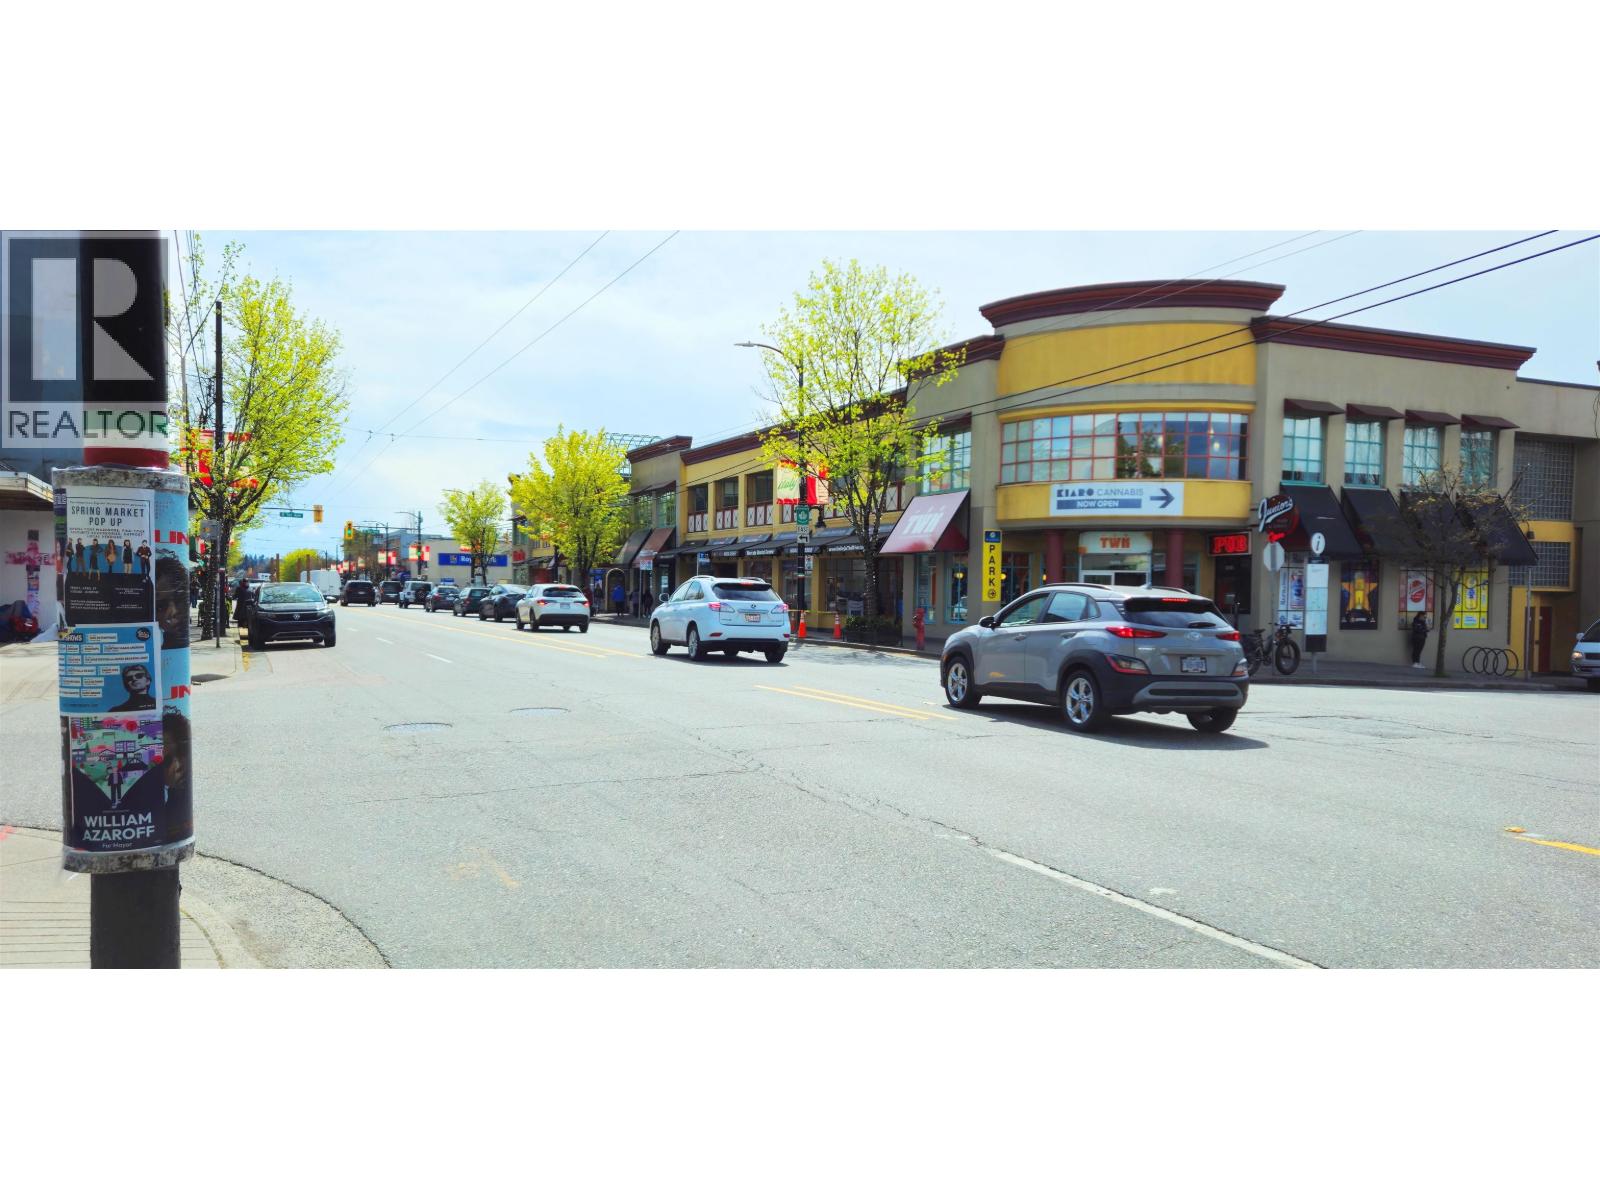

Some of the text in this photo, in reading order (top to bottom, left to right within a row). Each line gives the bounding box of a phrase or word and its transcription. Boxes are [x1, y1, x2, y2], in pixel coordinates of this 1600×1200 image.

[1056, 488, 1143, 497] KIARO CANNABIS
[1076, 499, 1119, 508] NOW OPEN
[72, 506, 101, 515] SPRING
[105, 508, 145, 517] MARKET
[89, 517, 122, 527] POP UP
[1215, 535, 1247, 552] PUB
[988, 544, 997, 587] PARK
[84, 812, 151, 827] WILLIAM
[83, 825, 155, 840] AZAROFF
